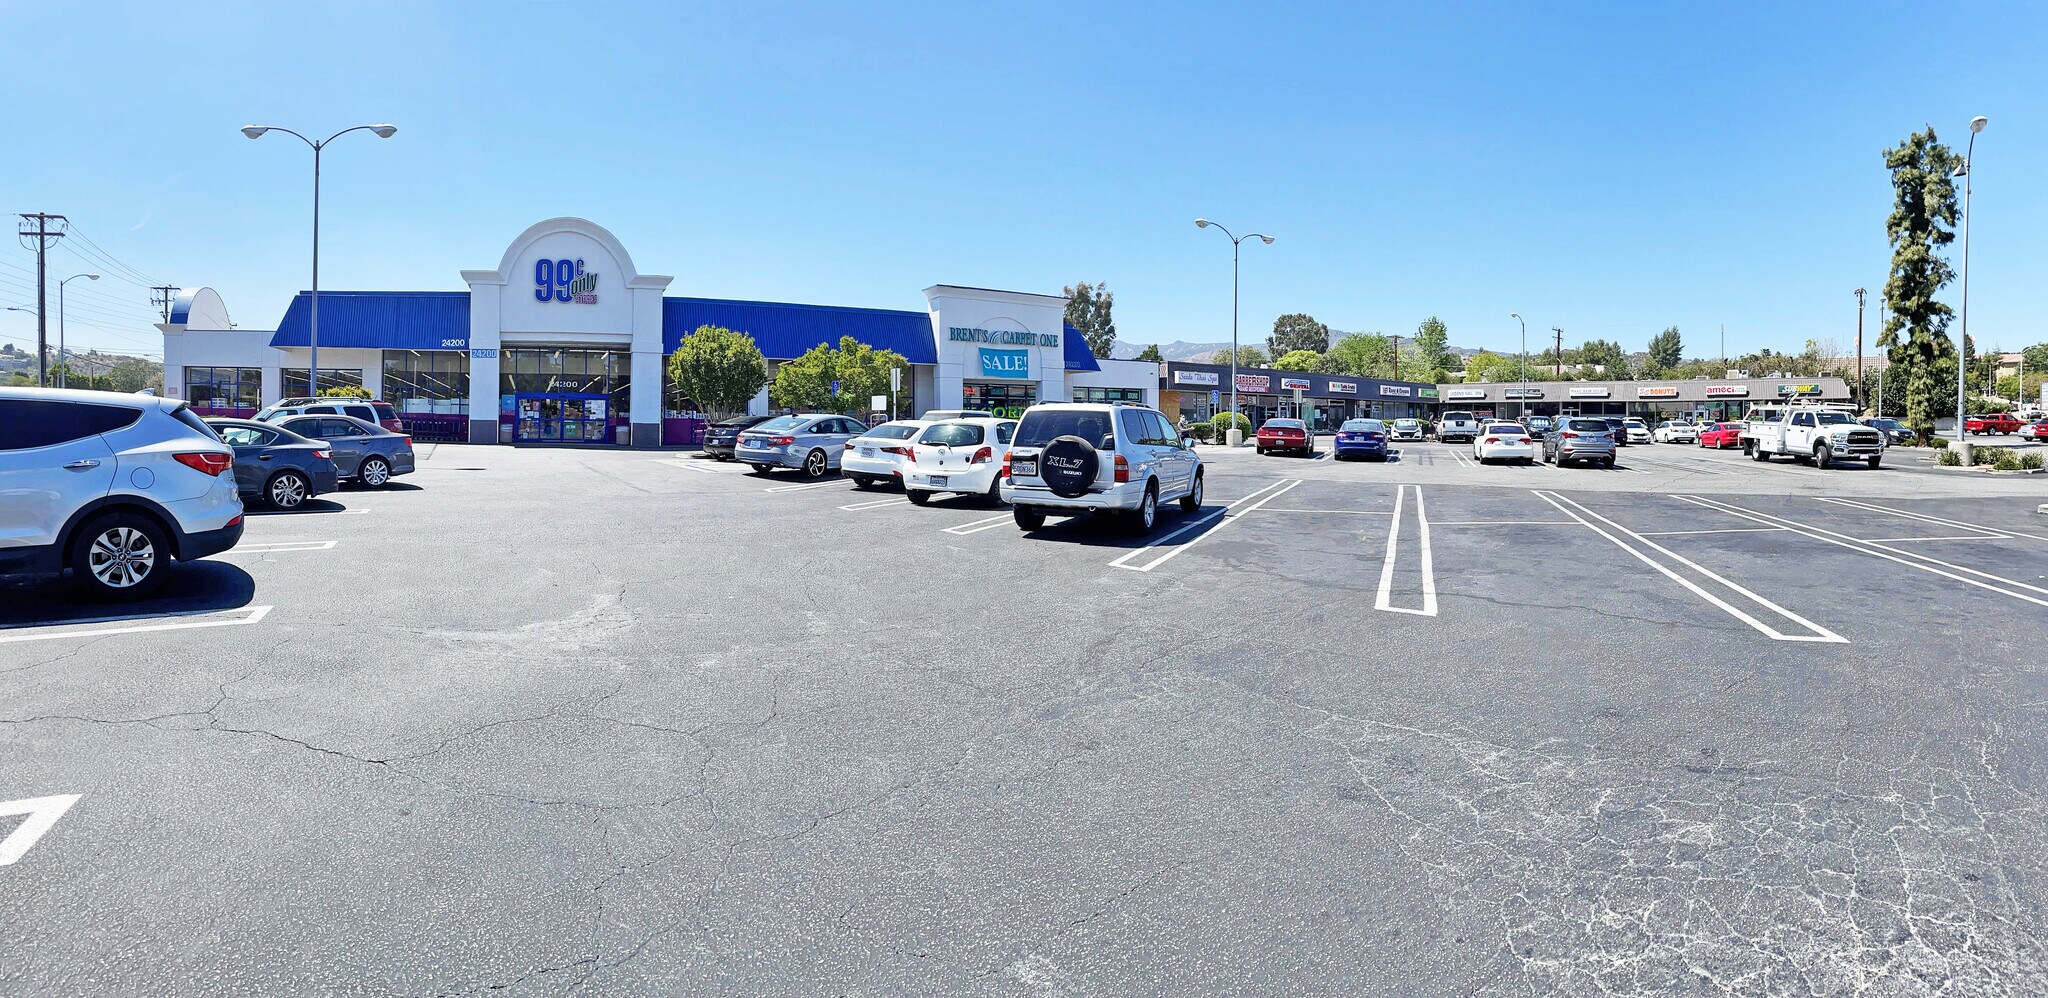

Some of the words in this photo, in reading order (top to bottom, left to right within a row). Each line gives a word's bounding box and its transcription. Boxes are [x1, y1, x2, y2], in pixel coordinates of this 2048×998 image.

[571, 272, 598, 295] only
[949, 327, 989, 343] BRENT'S
[1002, 331, 1037, 346] CARPET
[1039, 333, 1059, 347] ONE
[441, 339, 465, 347] 24200
[472, 349, 497, 358] 24200
[982, 354, 1028, 371] SALE!
[1706, 386, 1735, 394] ameci
[1781, 384, 1815, 393] SUBWAY
